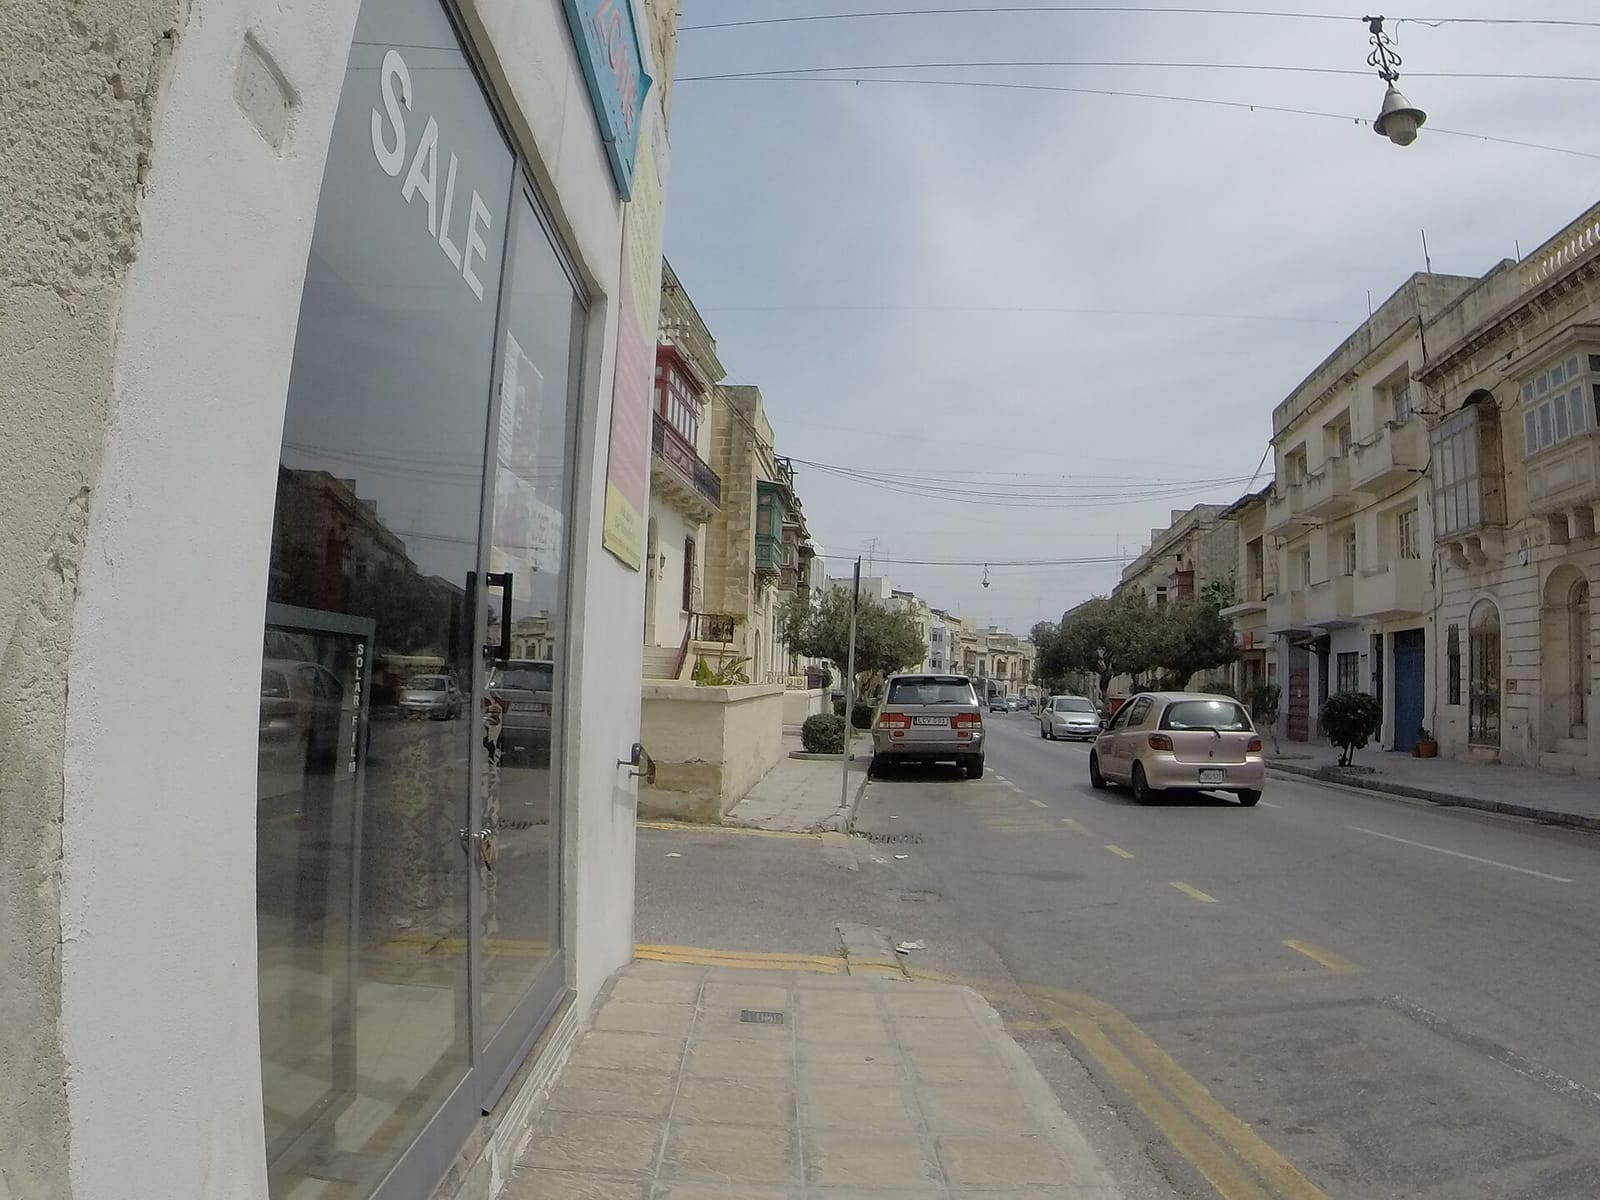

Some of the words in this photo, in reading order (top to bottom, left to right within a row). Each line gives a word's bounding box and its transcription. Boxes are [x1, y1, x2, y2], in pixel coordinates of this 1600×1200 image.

[371, 49, 492, 301] SALE
[353, 643, 365, 706] SOLAR
[348, 715, 358, 773] FILM
